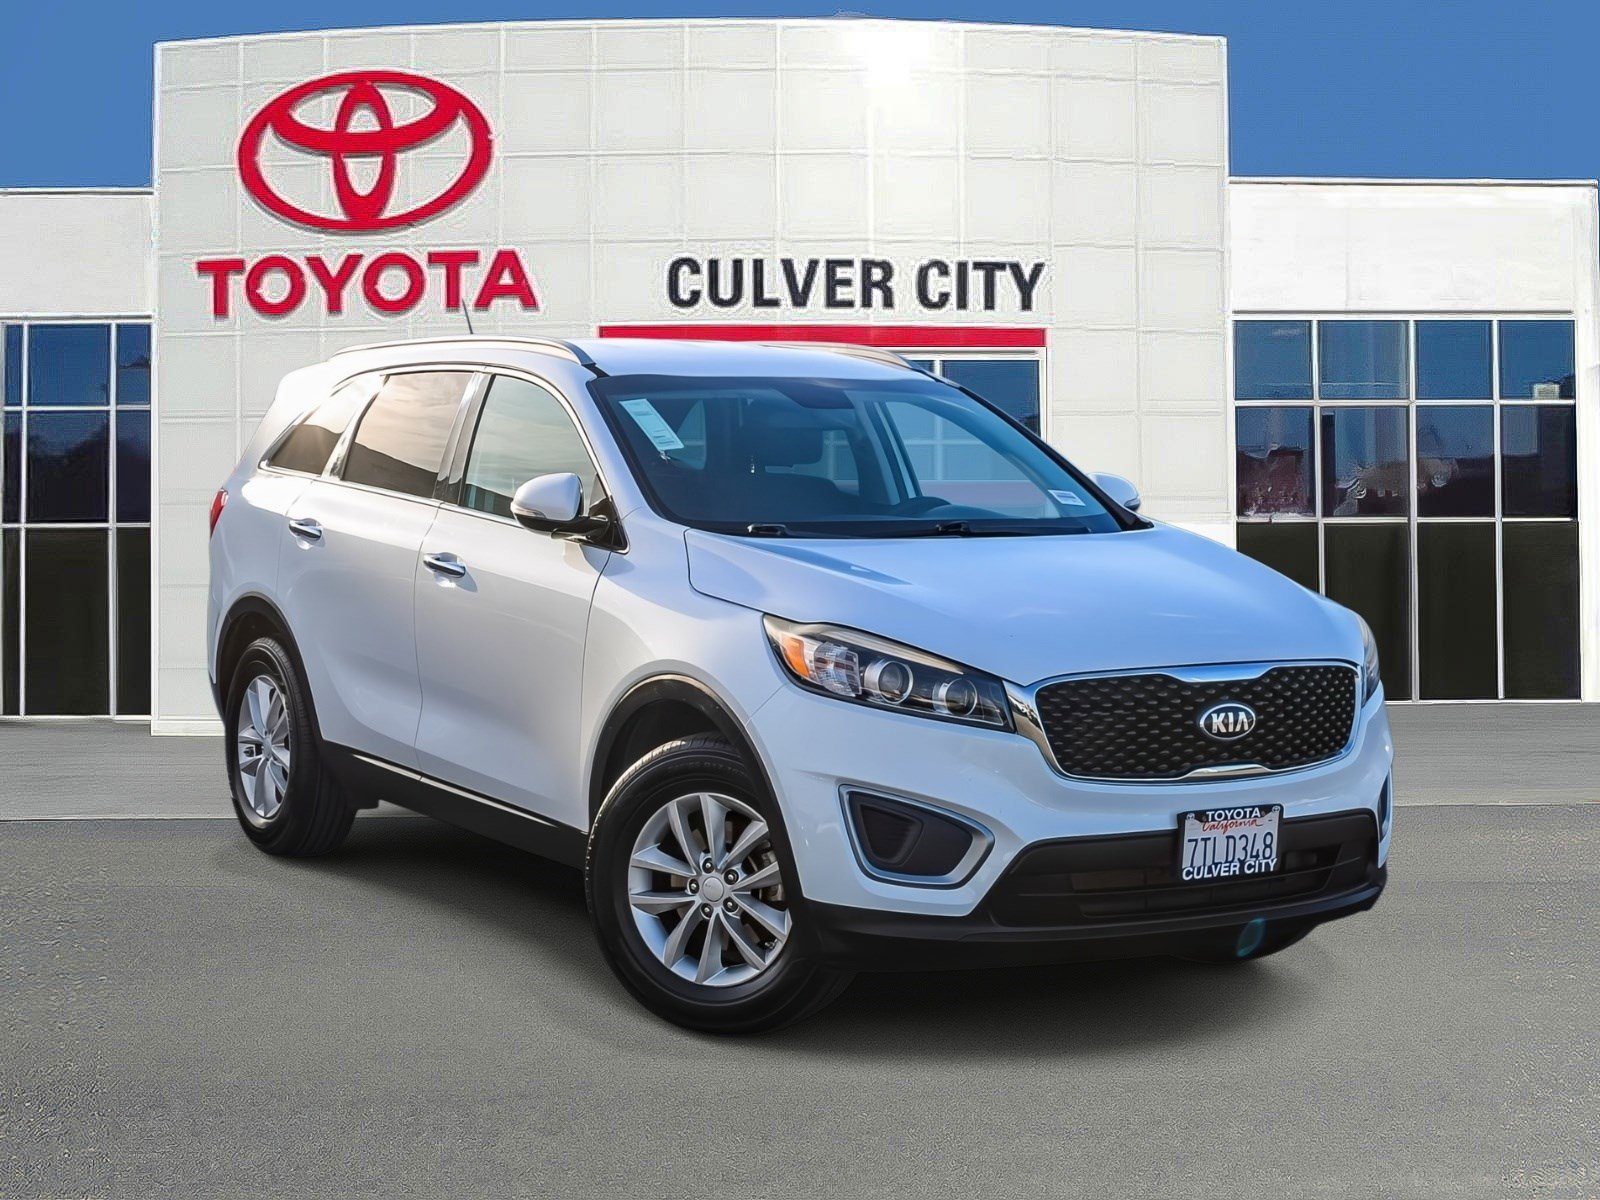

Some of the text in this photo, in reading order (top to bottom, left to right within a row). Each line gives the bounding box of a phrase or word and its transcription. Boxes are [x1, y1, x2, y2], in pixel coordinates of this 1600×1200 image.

[196, 249, 539, 319] TOYOTA
[667, 257, 1046, 311] CULVER CITY
[1211, 711, 1249, 734] KIA
[1206, 807, 1261, 822] TOYOTA
[1202, 819, 1264, 835] California
[1187, 831, 1274, 868] 7TLD348
[1182, 858, 1278, 881] CULVER CITY
